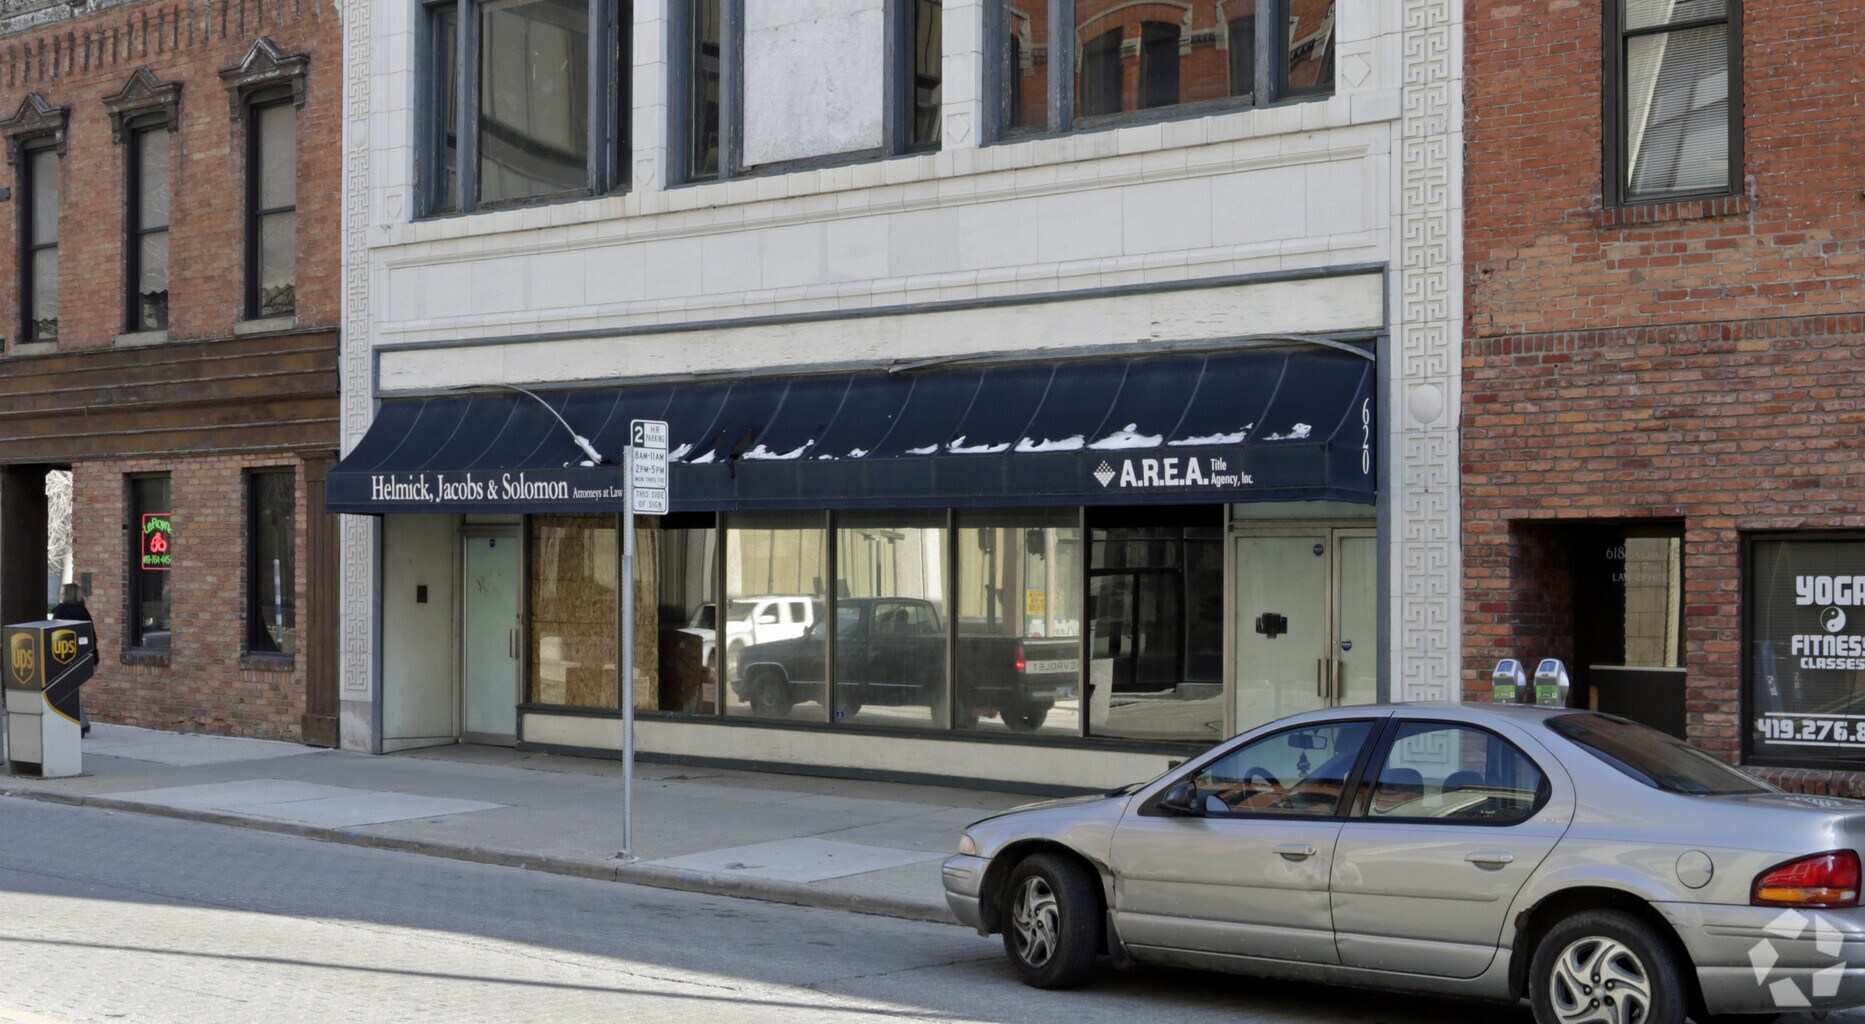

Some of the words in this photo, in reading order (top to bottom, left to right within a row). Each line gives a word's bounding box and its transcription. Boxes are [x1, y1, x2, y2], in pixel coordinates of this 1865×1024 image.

[634, 425, 643, 444] 2
[650, 426, 660, 434] HR
[1362, 398, 1370, 474] 620
[645, 435, 665, 444] PARKING
[634, 451, 665, 460] 8AM-11AM
[635, 465, 665, 474] 2PM-5PM
[1210, 457, 1227, 471] Title
[1120, 457, 1209, 487] A.R.E.A.
[1211, 472, 1240, 487] Agency,
[1241, 472, 1254, 484] Inc.
[371, 474, 433, 502] Helmick,
[436, 473, 483, 502] Jacobs
[487, 479, 499, 499] &
[502, 473, 569, 499] Solomon
[573, 487, 601, 501] Attorneys
[603, 489, 609, 498] at
[610, 486, 623, 497] Law
[636, 490, 649, 498] THIS
[651, 491, 664, 499] SIDE
[638, 500, 646, 508] OF
[649, 501, 662, 509] SIGN
[1606, 546, 1624, 559] 618
[1796, 576, 1865, 605] YOGA
[54, 640, 75, 659] ups
[13, 648, 33, 676] ups
[1800, 658, 1865, 670] CLASSES
